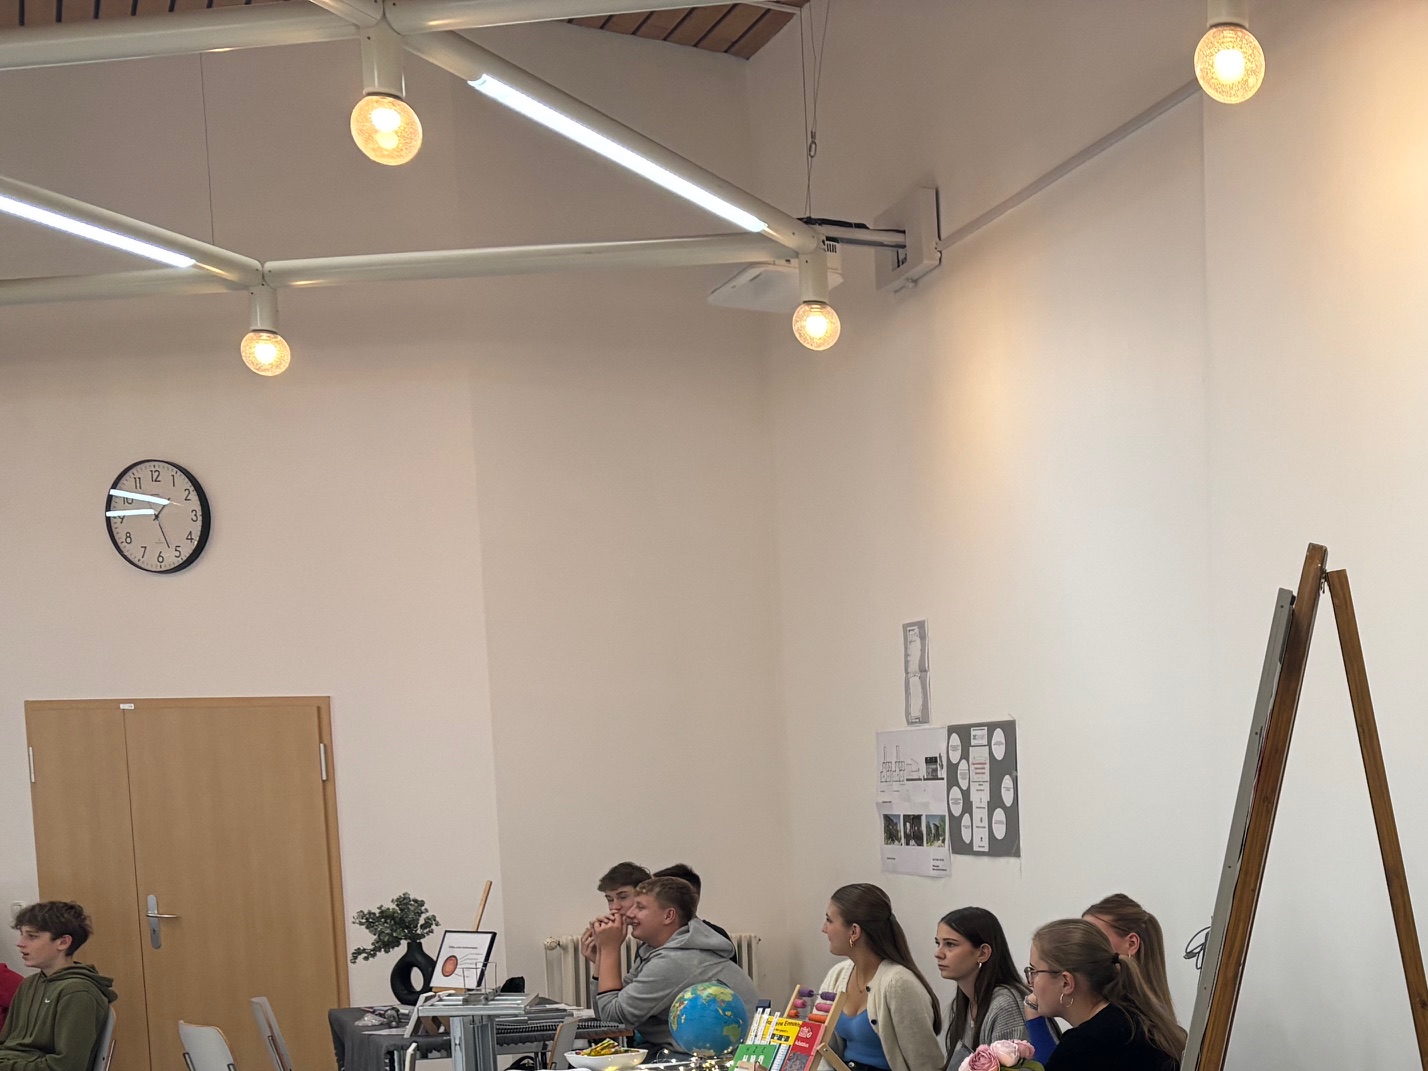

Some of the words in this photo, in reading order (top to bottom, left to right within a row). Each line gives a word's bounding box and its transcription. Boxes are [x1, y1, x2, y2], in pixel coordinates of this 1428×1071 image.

[150, 470, 161, 482] 12
[171, 474, 176, 487] 1
[134, 477, 142, 490] 11
[184, 488, 191, 501] 2
[191, 509, 199, 522] 3
[125, 532, 132, 544] 8
[186, 530, 194, 543] 4
[141, 546, 147, 559] 7
[157, 551, 164, 563] 6
[175, 546, 181, 558] 5
